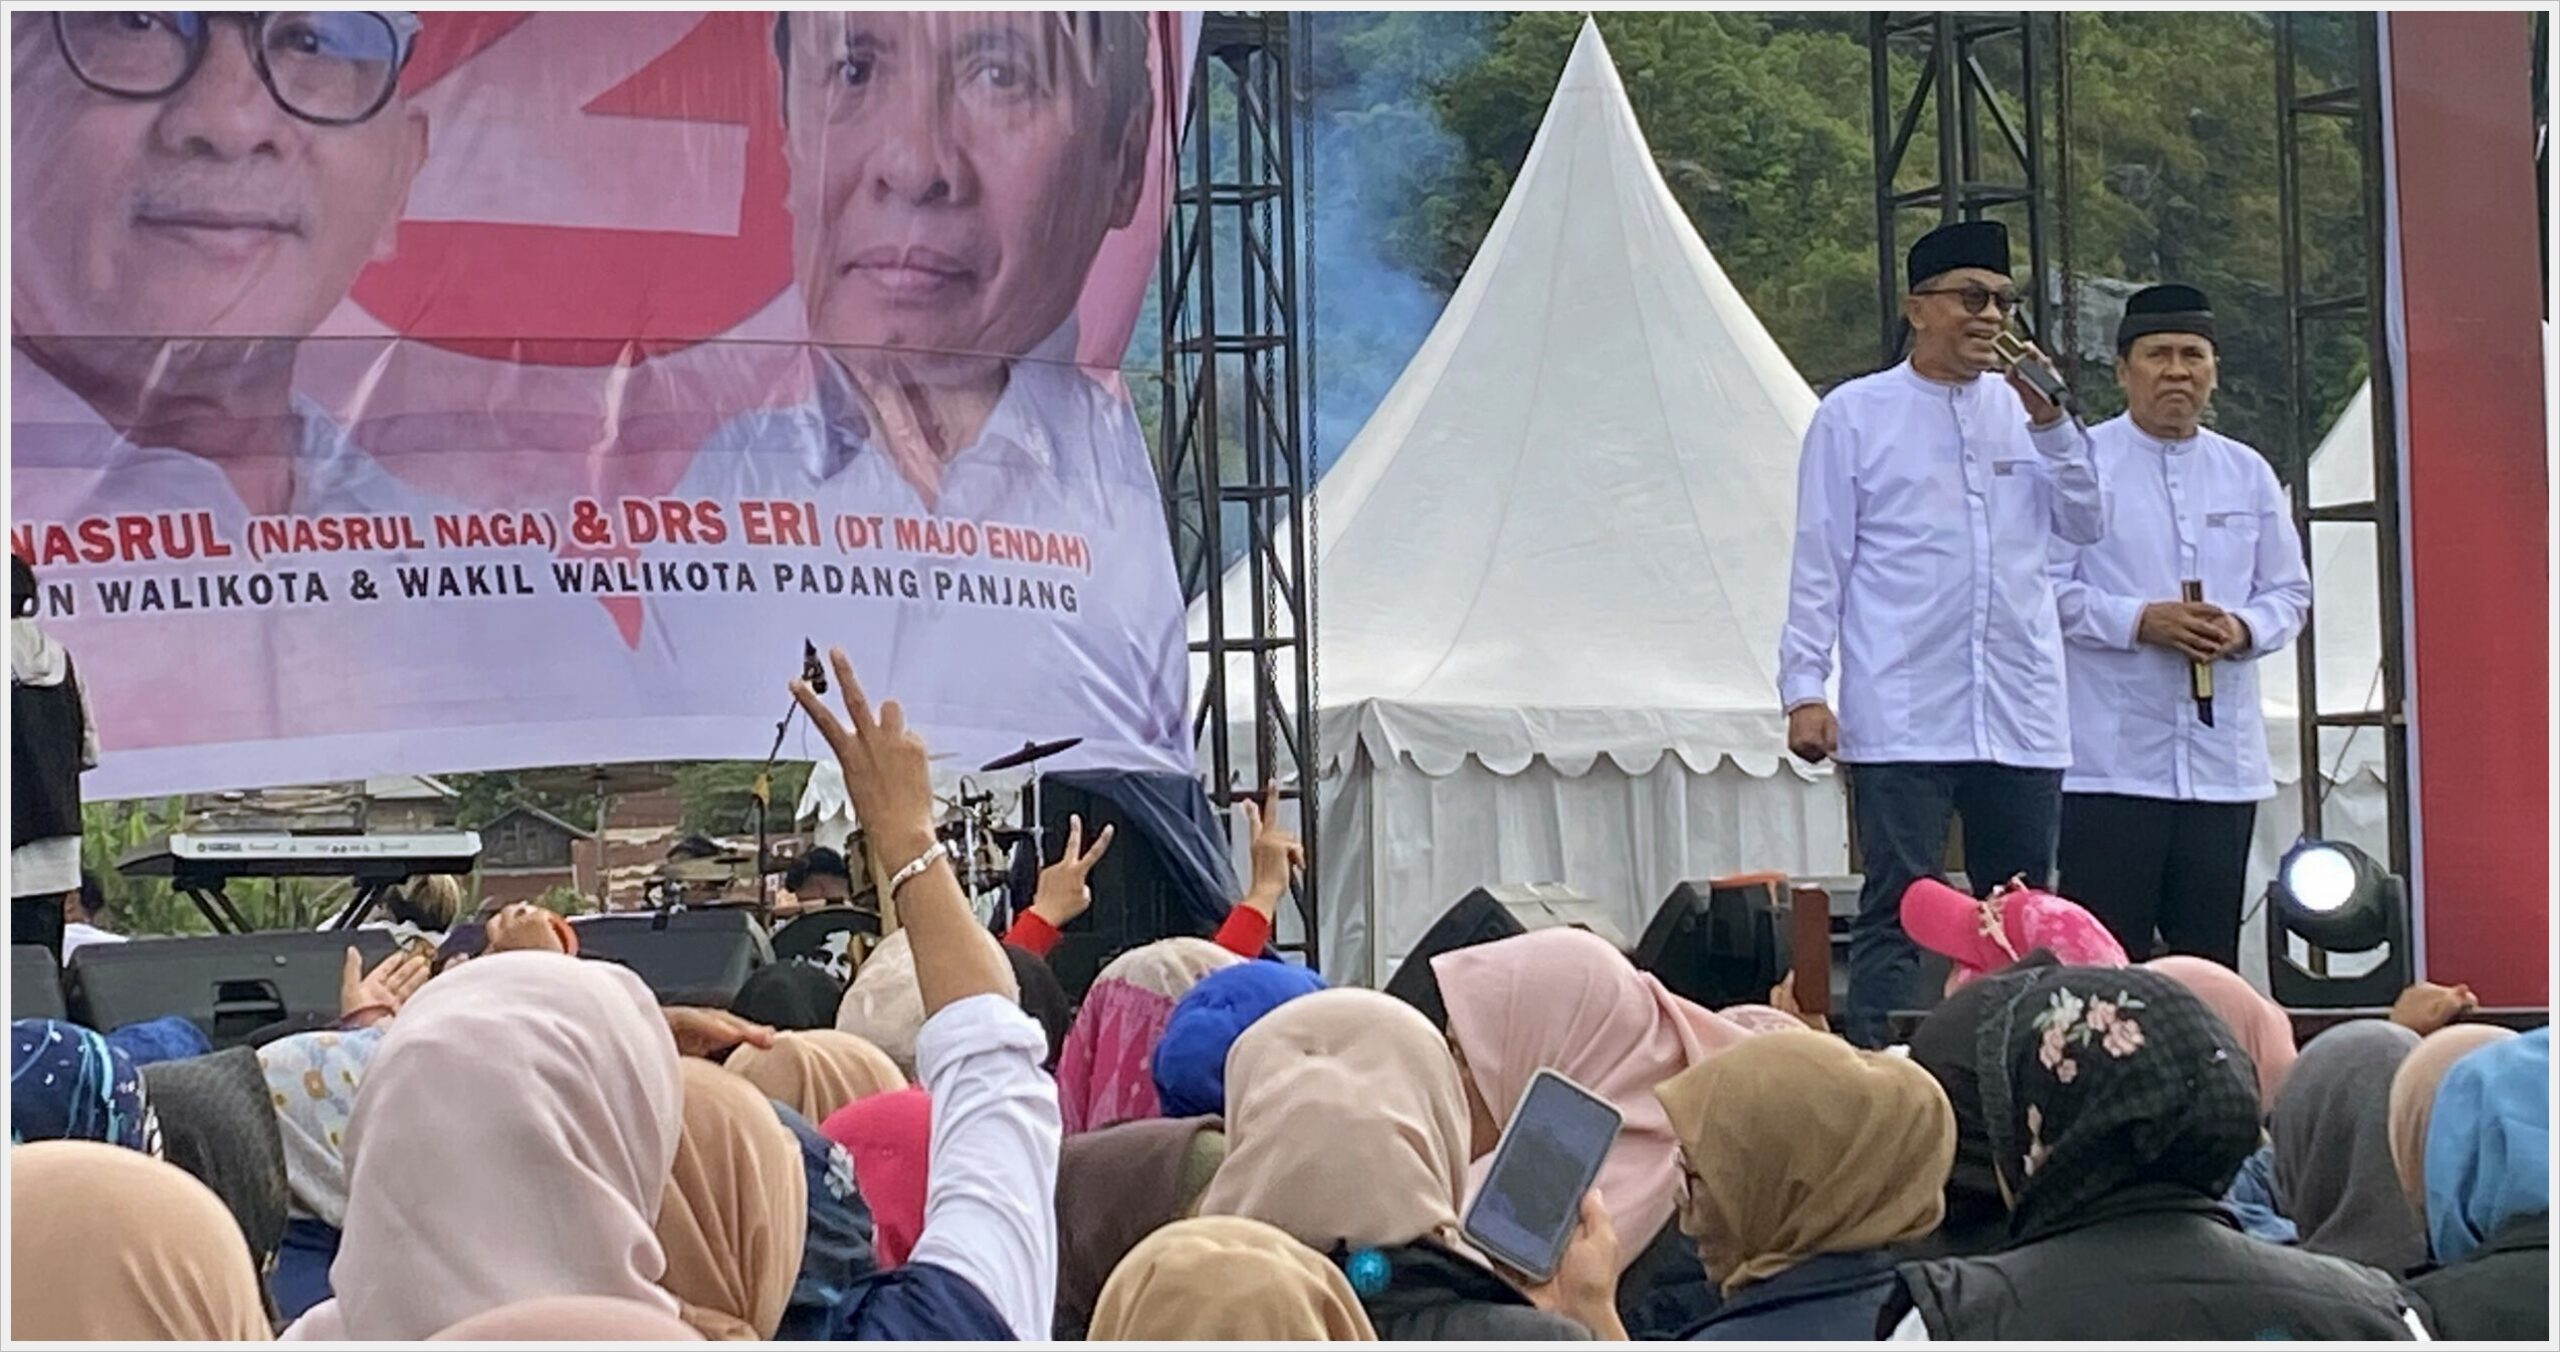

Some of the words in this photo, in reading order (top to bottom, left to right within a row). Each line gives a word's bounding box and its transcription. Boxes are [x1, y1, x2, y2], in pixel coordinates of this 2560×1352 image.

[11, 512, 232, 565] NASRUL
[247, 515, 425, 562] (NASRUL
[434, 512, 556, 552] NAGA)
[572, 500, 611, 544] &
[623, 500, 727, 544] DRS
[740, 502, 821, 546] ERI
[835, 514, 883, 555] (DT
[894, 517, 978, 556] MAJO
[986, 526, 1091, 577] ENDAH)
[98, 572, 329, 613] WALIKOTA
[351, 569, 378, 600] &
[396, 564, 534, 598] WAKIL
[552, 561, 757, 592] WALIKOTA
[773, 562, 920, 599] PADANG
[934, 570, 1077, 613] PANJANG
